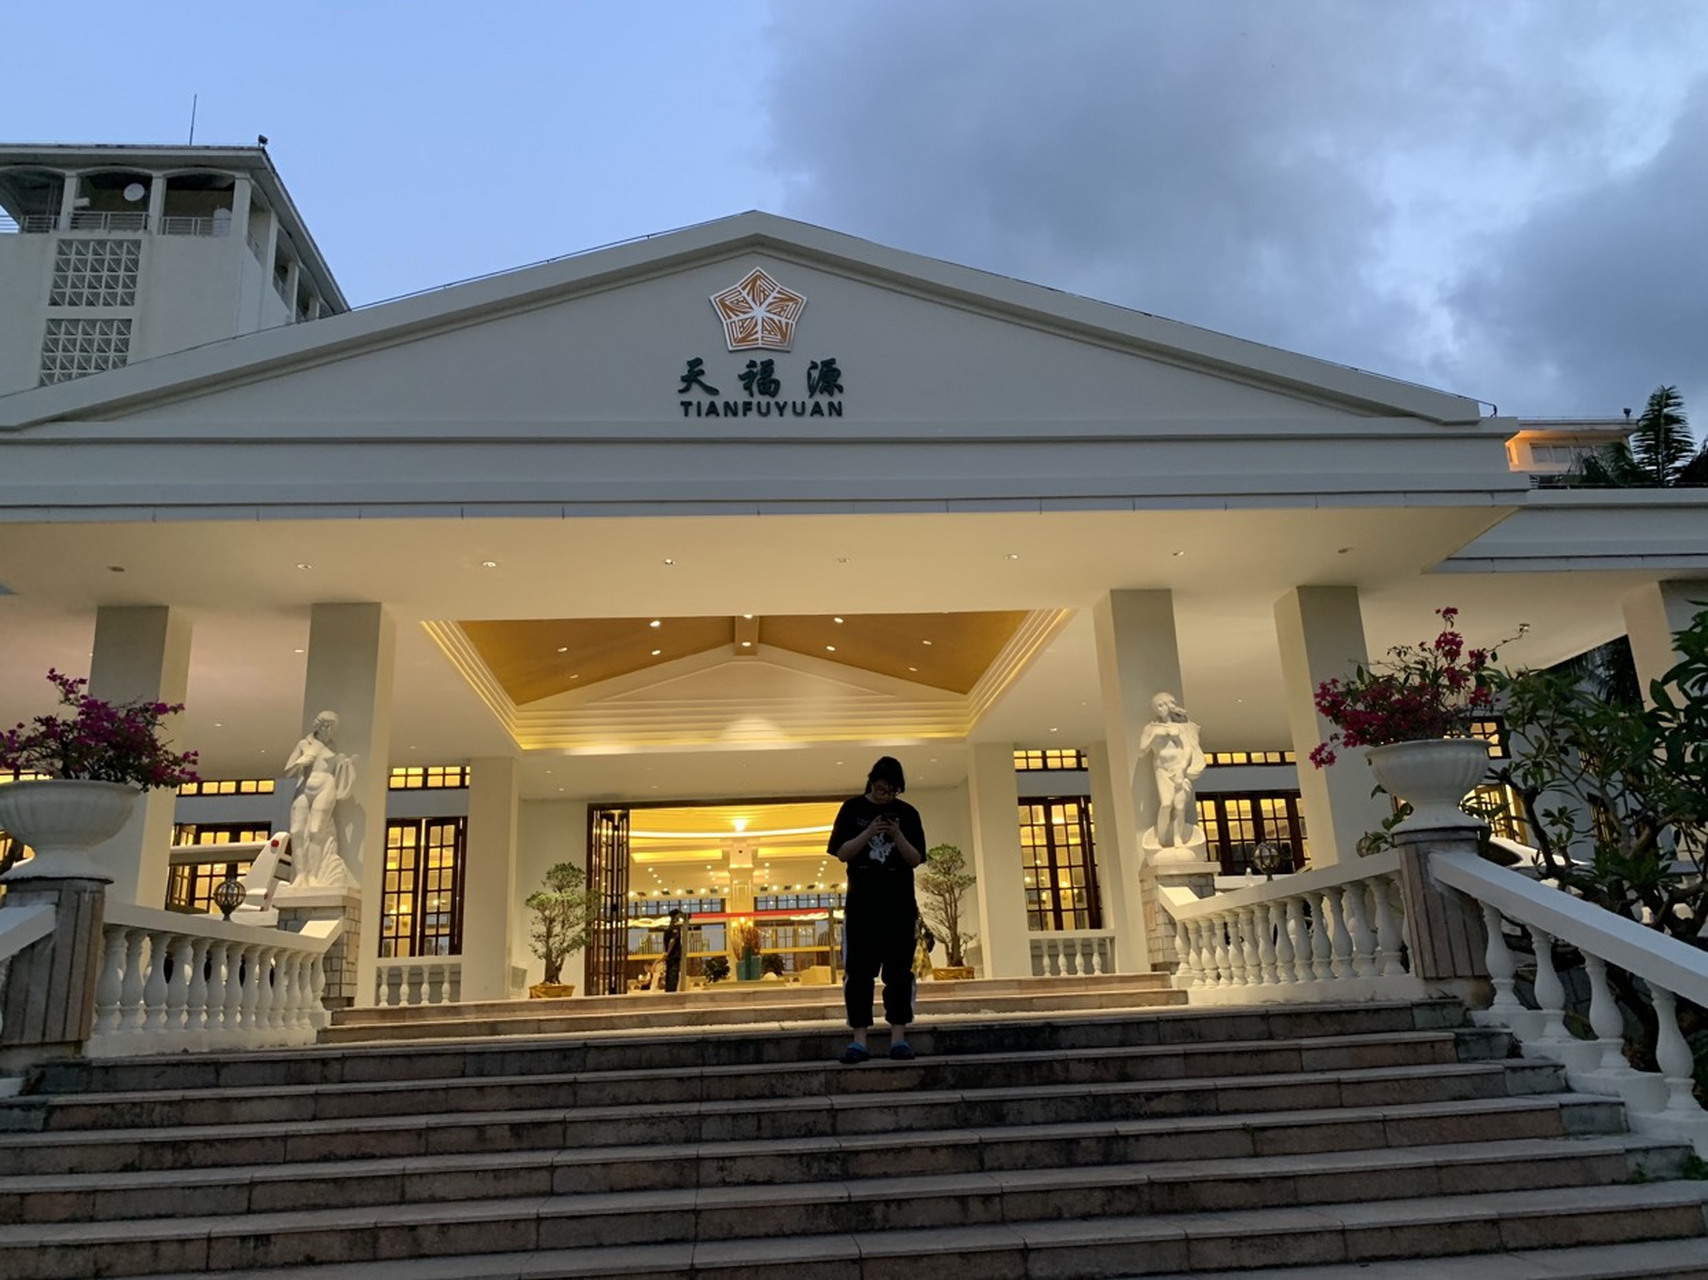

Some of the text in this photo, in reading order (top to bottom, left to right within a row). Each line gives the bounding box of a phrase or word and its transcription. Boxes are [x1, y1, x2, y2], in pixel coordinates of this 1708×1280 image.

[678, 357, 844, 398] 天福源
[680, 401, 843, 417] TIANFUYUAN
